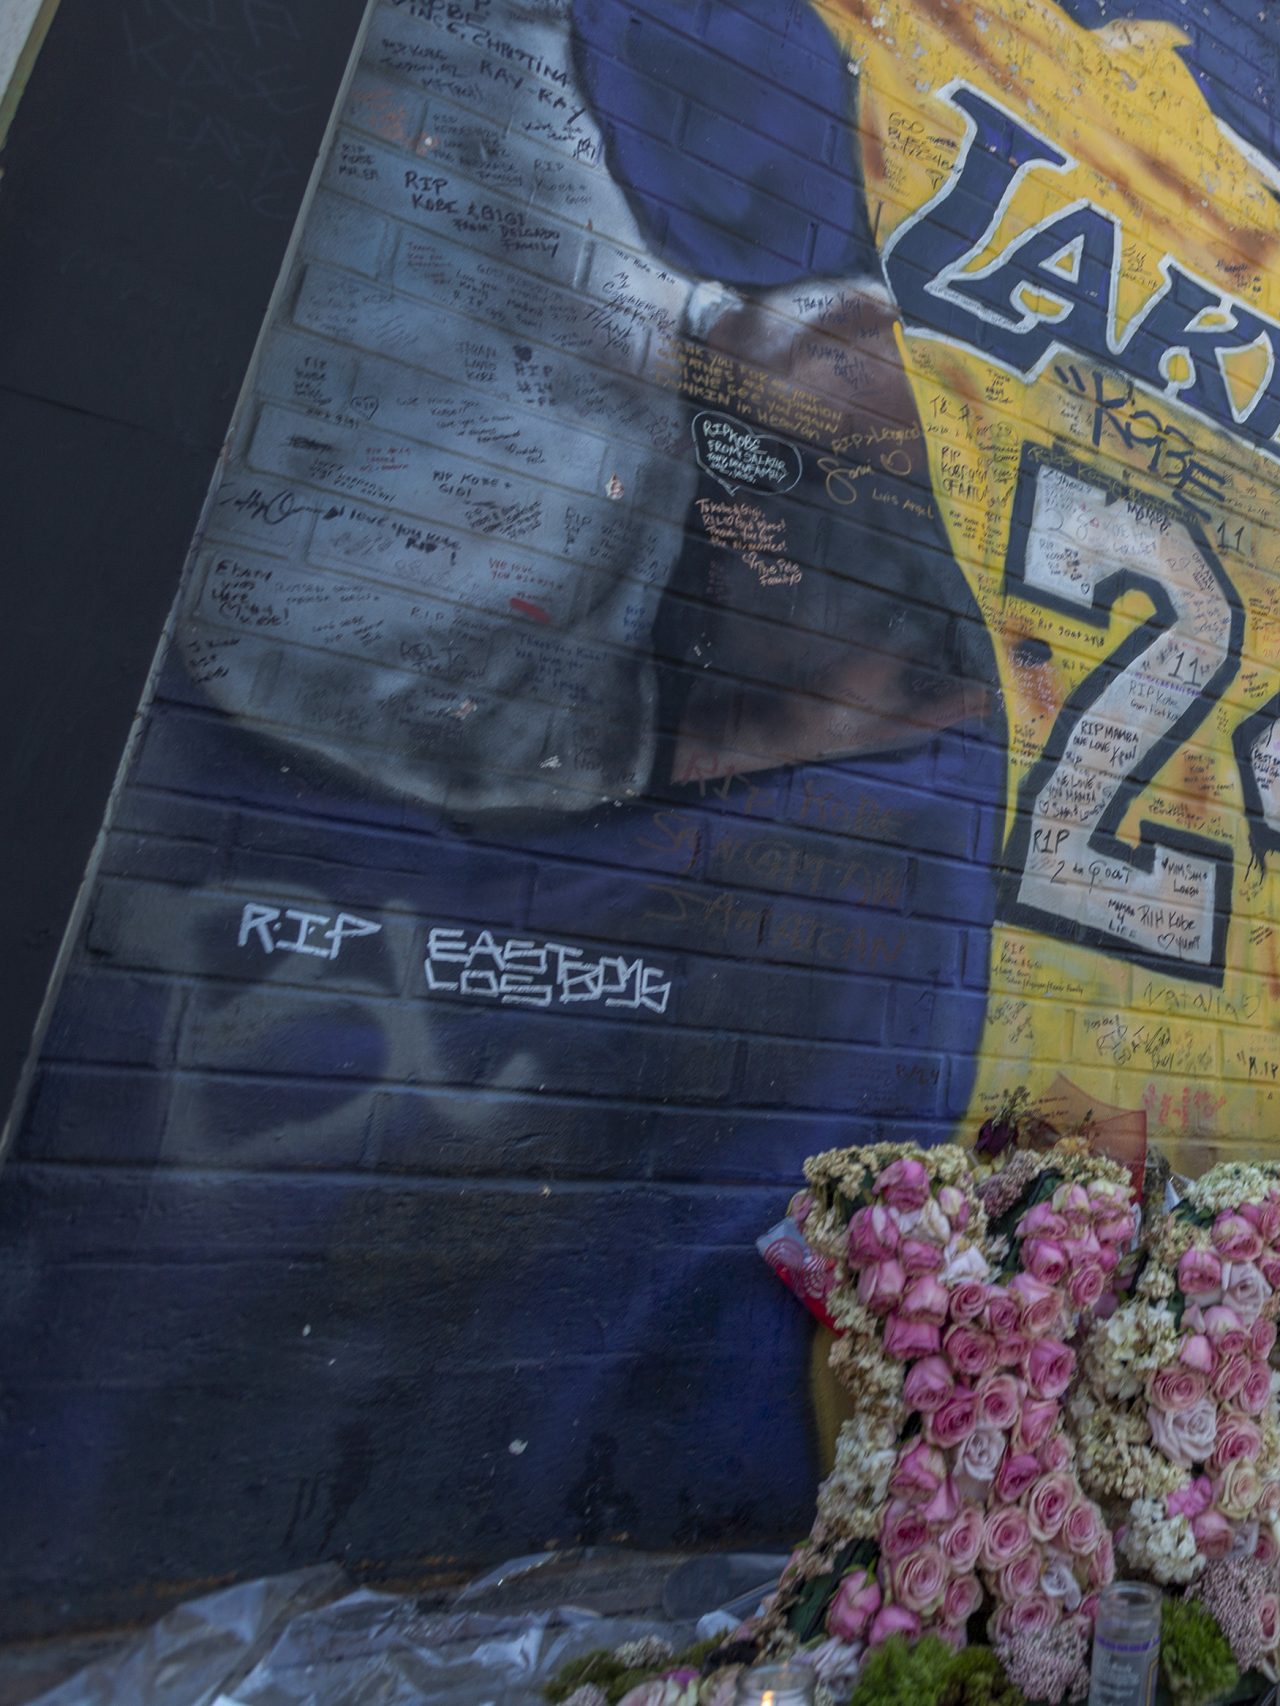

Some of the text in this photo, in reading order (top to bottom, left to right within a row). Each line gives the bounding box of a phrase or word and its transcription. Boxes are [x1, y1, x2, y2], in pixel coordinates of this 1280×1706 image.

[404, 170, 448, 194] RIP
[412, 193, 459, 214] KOBE
[1080, 720, 1105, 736] RIP
[1033, 828, 1070, 854] RIP
